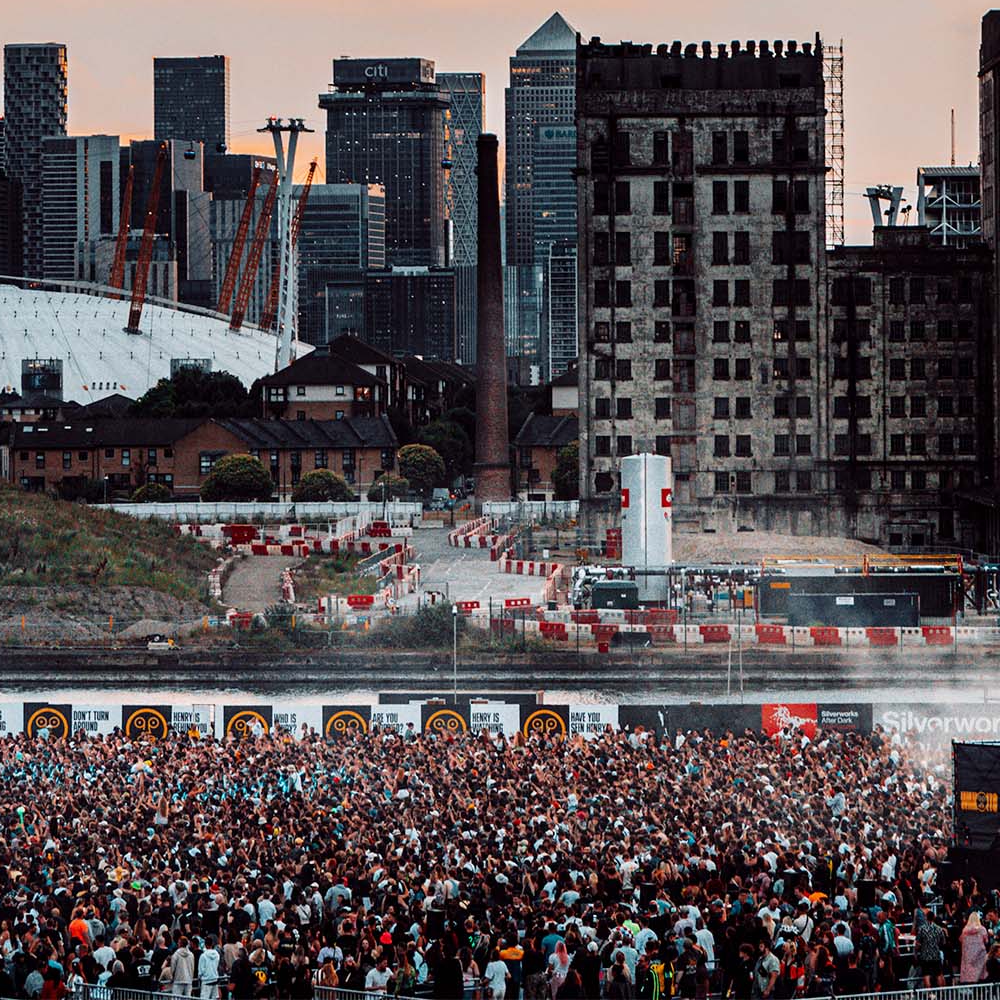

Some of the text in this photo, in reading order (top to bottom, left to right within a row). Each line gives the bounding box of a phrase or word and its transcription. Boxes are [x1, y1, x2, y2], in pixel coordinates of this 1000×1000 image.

[364, 63, 389, 78] citi
[73, 710, 110, 721] DON'T TURN
[173, 712, 193, 722] HENRY
[290, 713, 297, 723] IS
[386, 712, 399, 723] YOU
[472, 712, 500, 723] HENRY IS
[571, 712, 601, 722] HAVE YOU
[571, 722, 585, 733] SEEN
